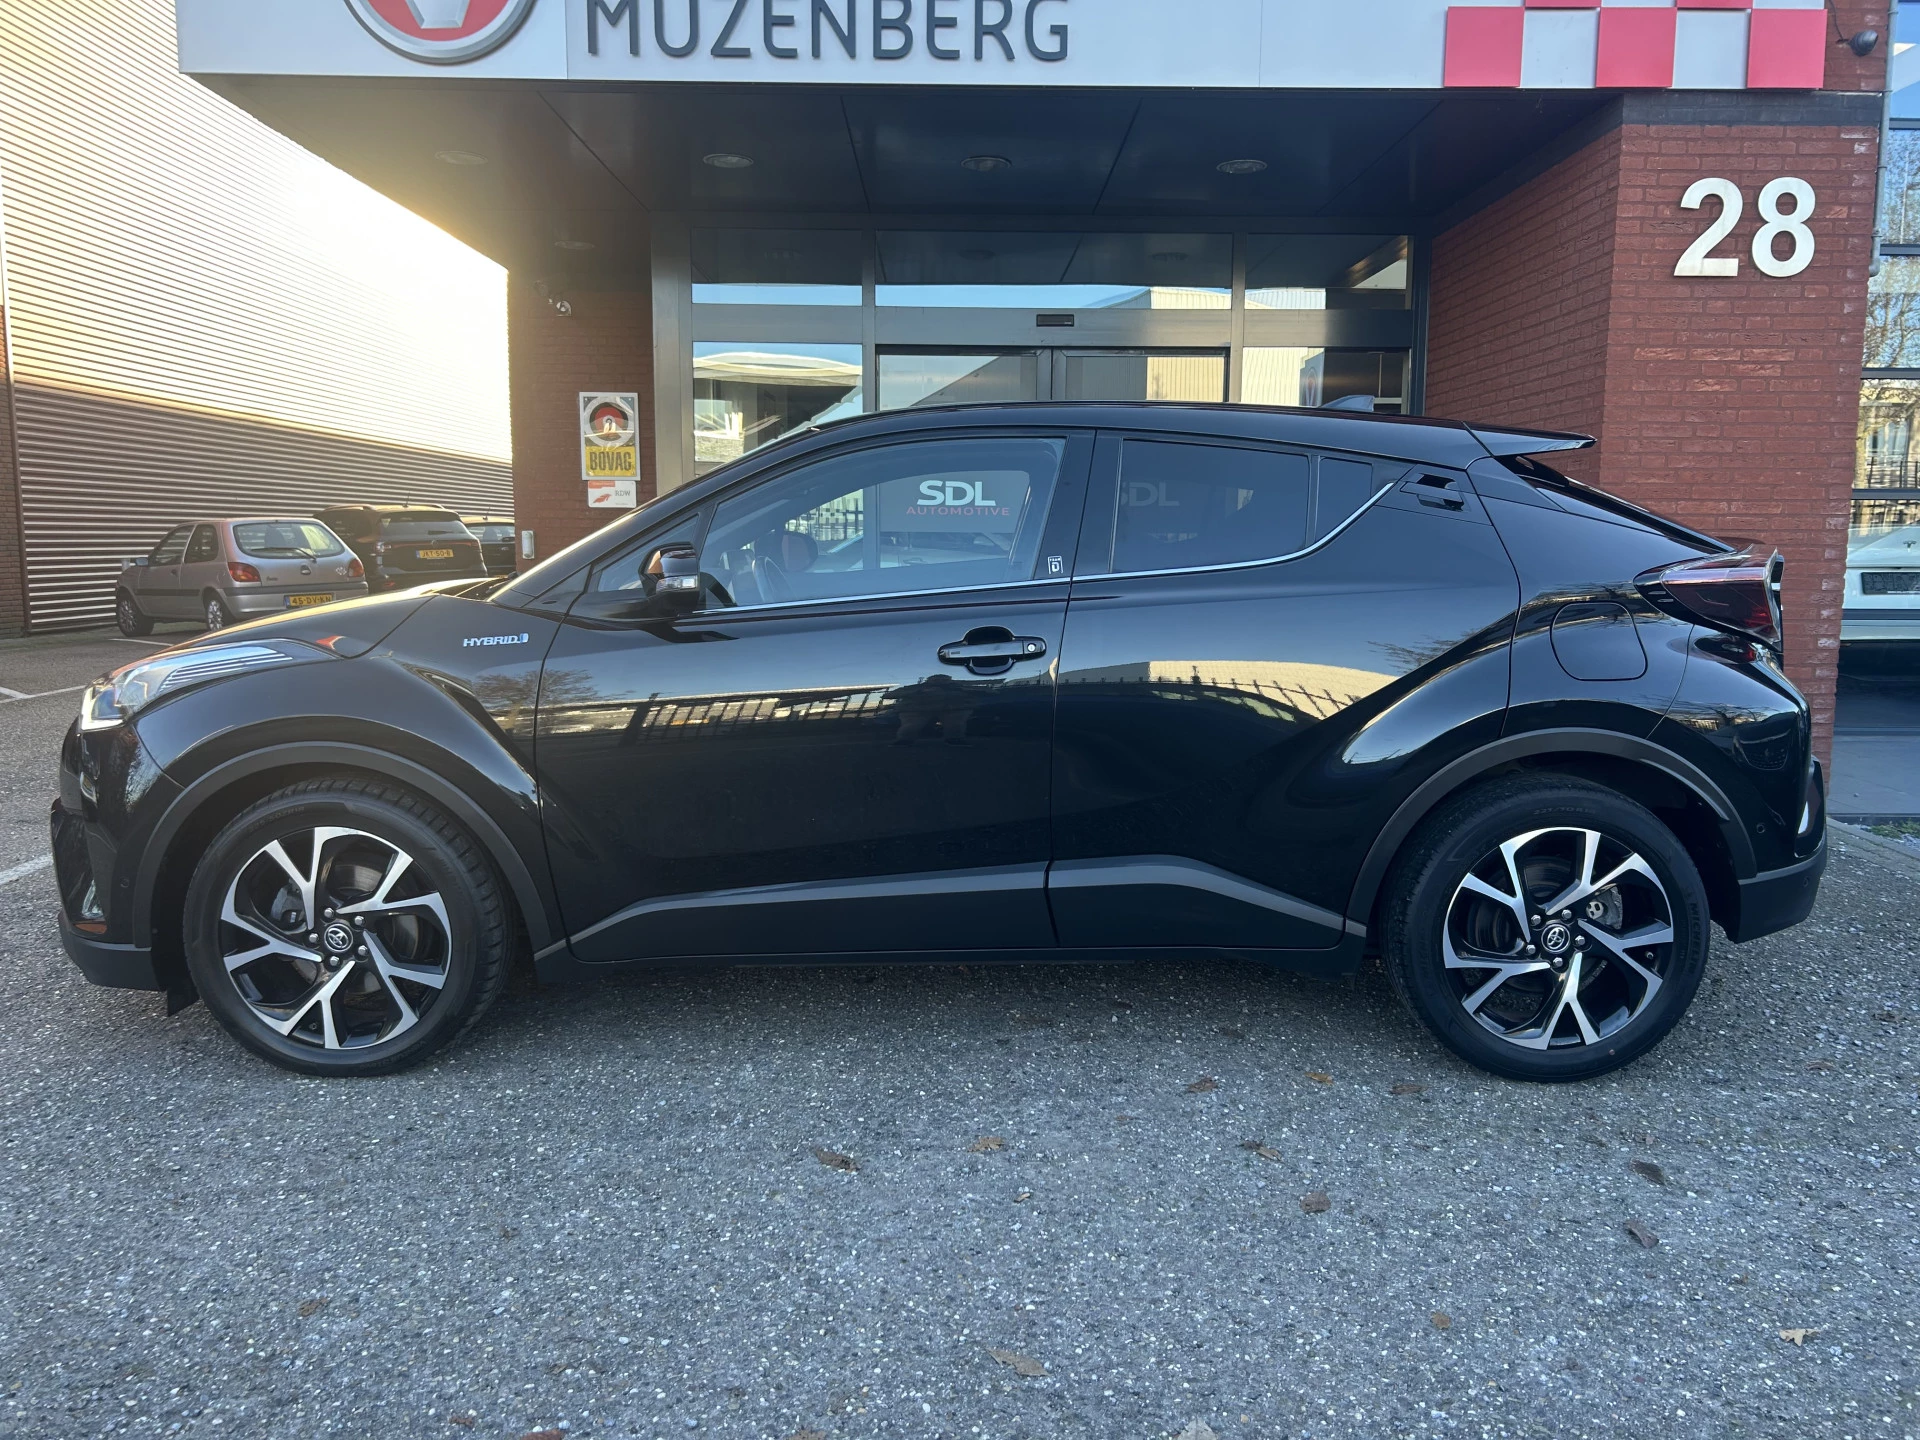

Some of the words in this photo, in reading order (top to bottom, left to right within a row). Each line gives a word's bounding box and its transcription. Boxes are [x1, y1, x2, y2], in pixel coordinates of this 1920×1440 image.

[1674, 176, 1816, 277] 28
[590, 451, 632, 471] BOVAG
[917, 480, 996, 506] SDL
[906, 506, 1009, 516] AUTOMOTIVE
[463, 635, 519, 647] HYBRID
